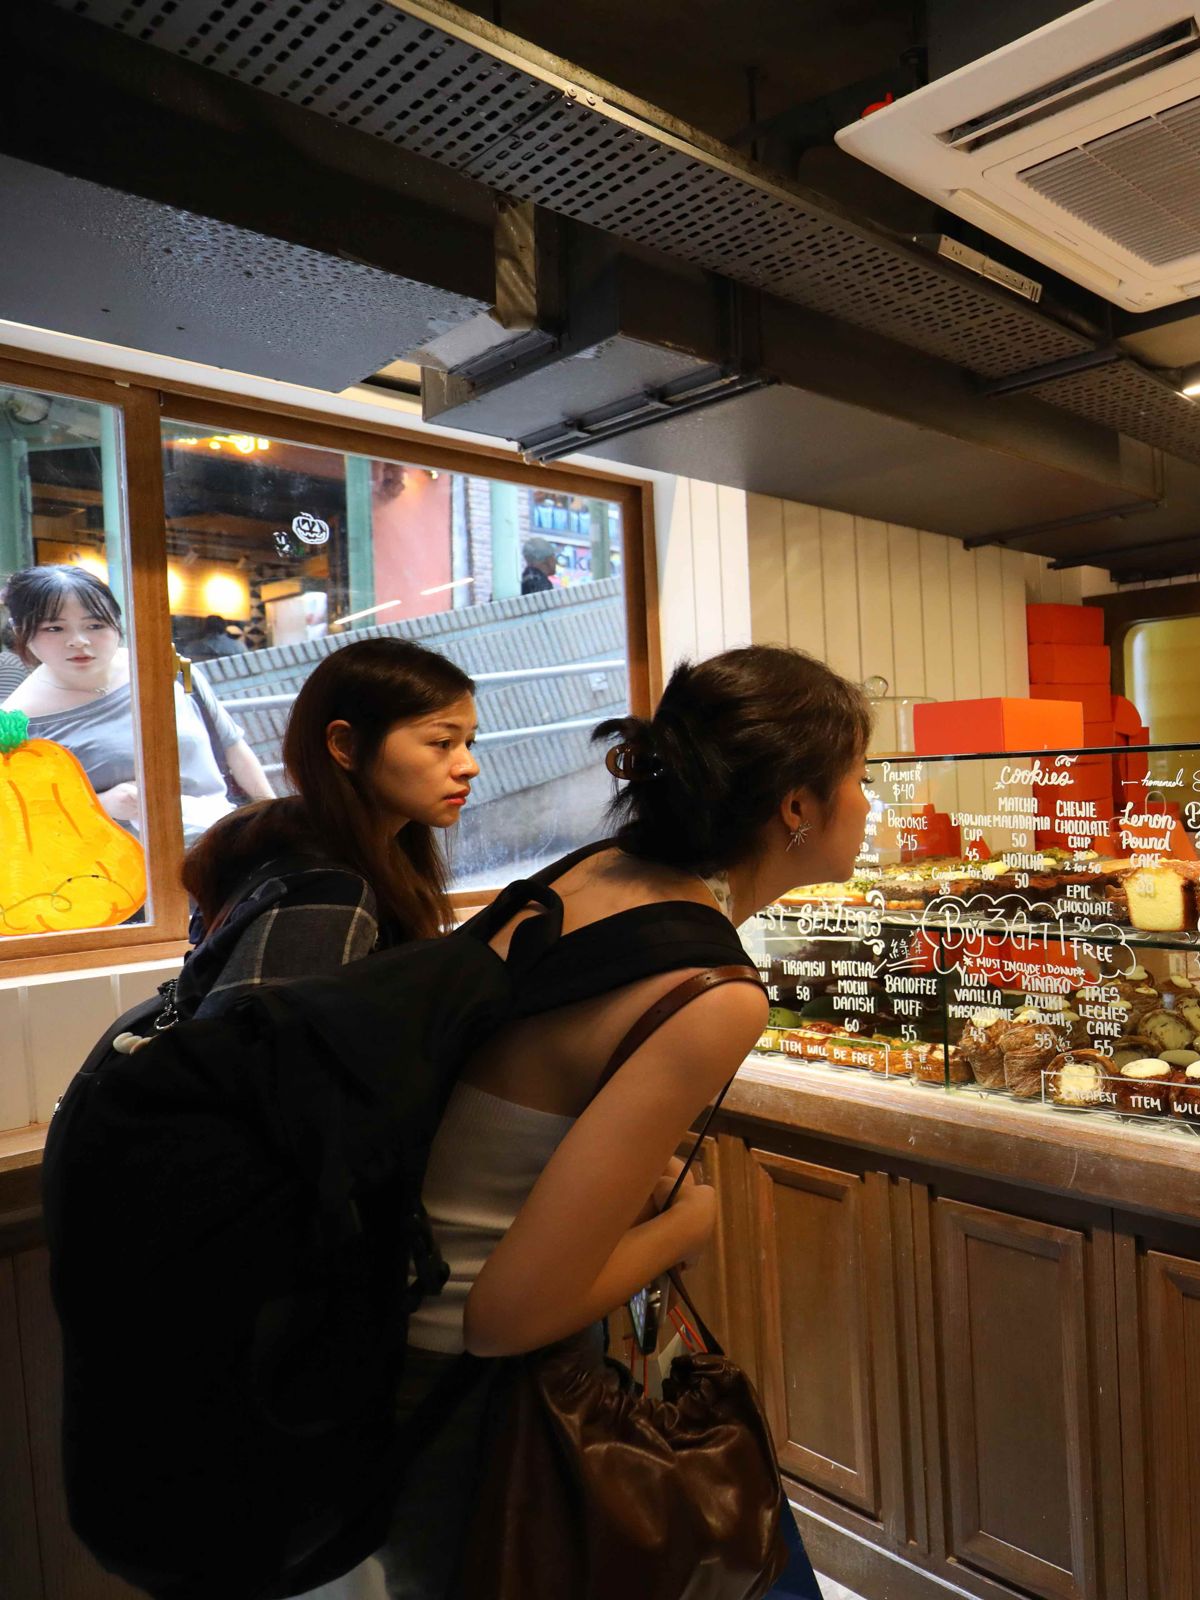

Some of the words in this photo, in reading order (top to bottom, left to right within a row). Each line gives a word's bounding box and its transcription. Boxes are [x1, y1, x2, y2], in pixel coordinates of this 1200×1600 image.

[881, 762, 921, 782] PALMIER
[892, 783, 915, 801] $40
[998, 797, 1038, 813] MATCHA
[888, 809, 928, 830] BROOKIE
[1055, 819, 1111, 837] CHOCOLATE
[896, 833, 918, 851] $45
[964, 827, 983, 841] CUP
[1011, 833, 1027, 848] 50
[1068, 835, 1092, 849] CHIP
[1119, 830, 1171, 851] Pound
[965, 847, 980, 861] 45
[1014, 873, 1029, 888] 50
[1066, 884, 1092, 899] EPIC
[1057, 898, 1113, 917] CHOCOLATE
[1073, 916, 1092, 933] 50
[1070, 937, 1113, 963] FREE
[782, 959, 826, 977] TIRAMISU
[831, 960, 873, 977] MATCHA
[976, 957, 1001, 969] MUST
[957, 964, 989, 987] YUZU
[796, 985, 810, 1001] 58
[837, 980, 868, 995] MOCHI
[884, 974, 937, 995] BANOFFEE
[954, 988, 1002, 1006] VANILLA
[1082, 985, 1121, 1004] TRES
[833, 996, 875, 1014] DANISH
[893, 999, 923, 1016] PUFF
[1079, 1004, 1129, 1022] LECHES
[844, 1017, 860, 1032] 60
[1086, 1021, 1122, 1037] CAKE
[901, 1024, 917, 1043] 55
[970, 1027, 986, 1043] 45
[1034, 1033, 1053, 1049] 55
[807, 1045, 829, 1057] WILL
[834, 1049, 846, 1060] BE
[852, 1052, 875, 1067] FREE
[1094, 1040, 1114, 1057] 55
[1130, 1095, 1161, 1112] ITEM
